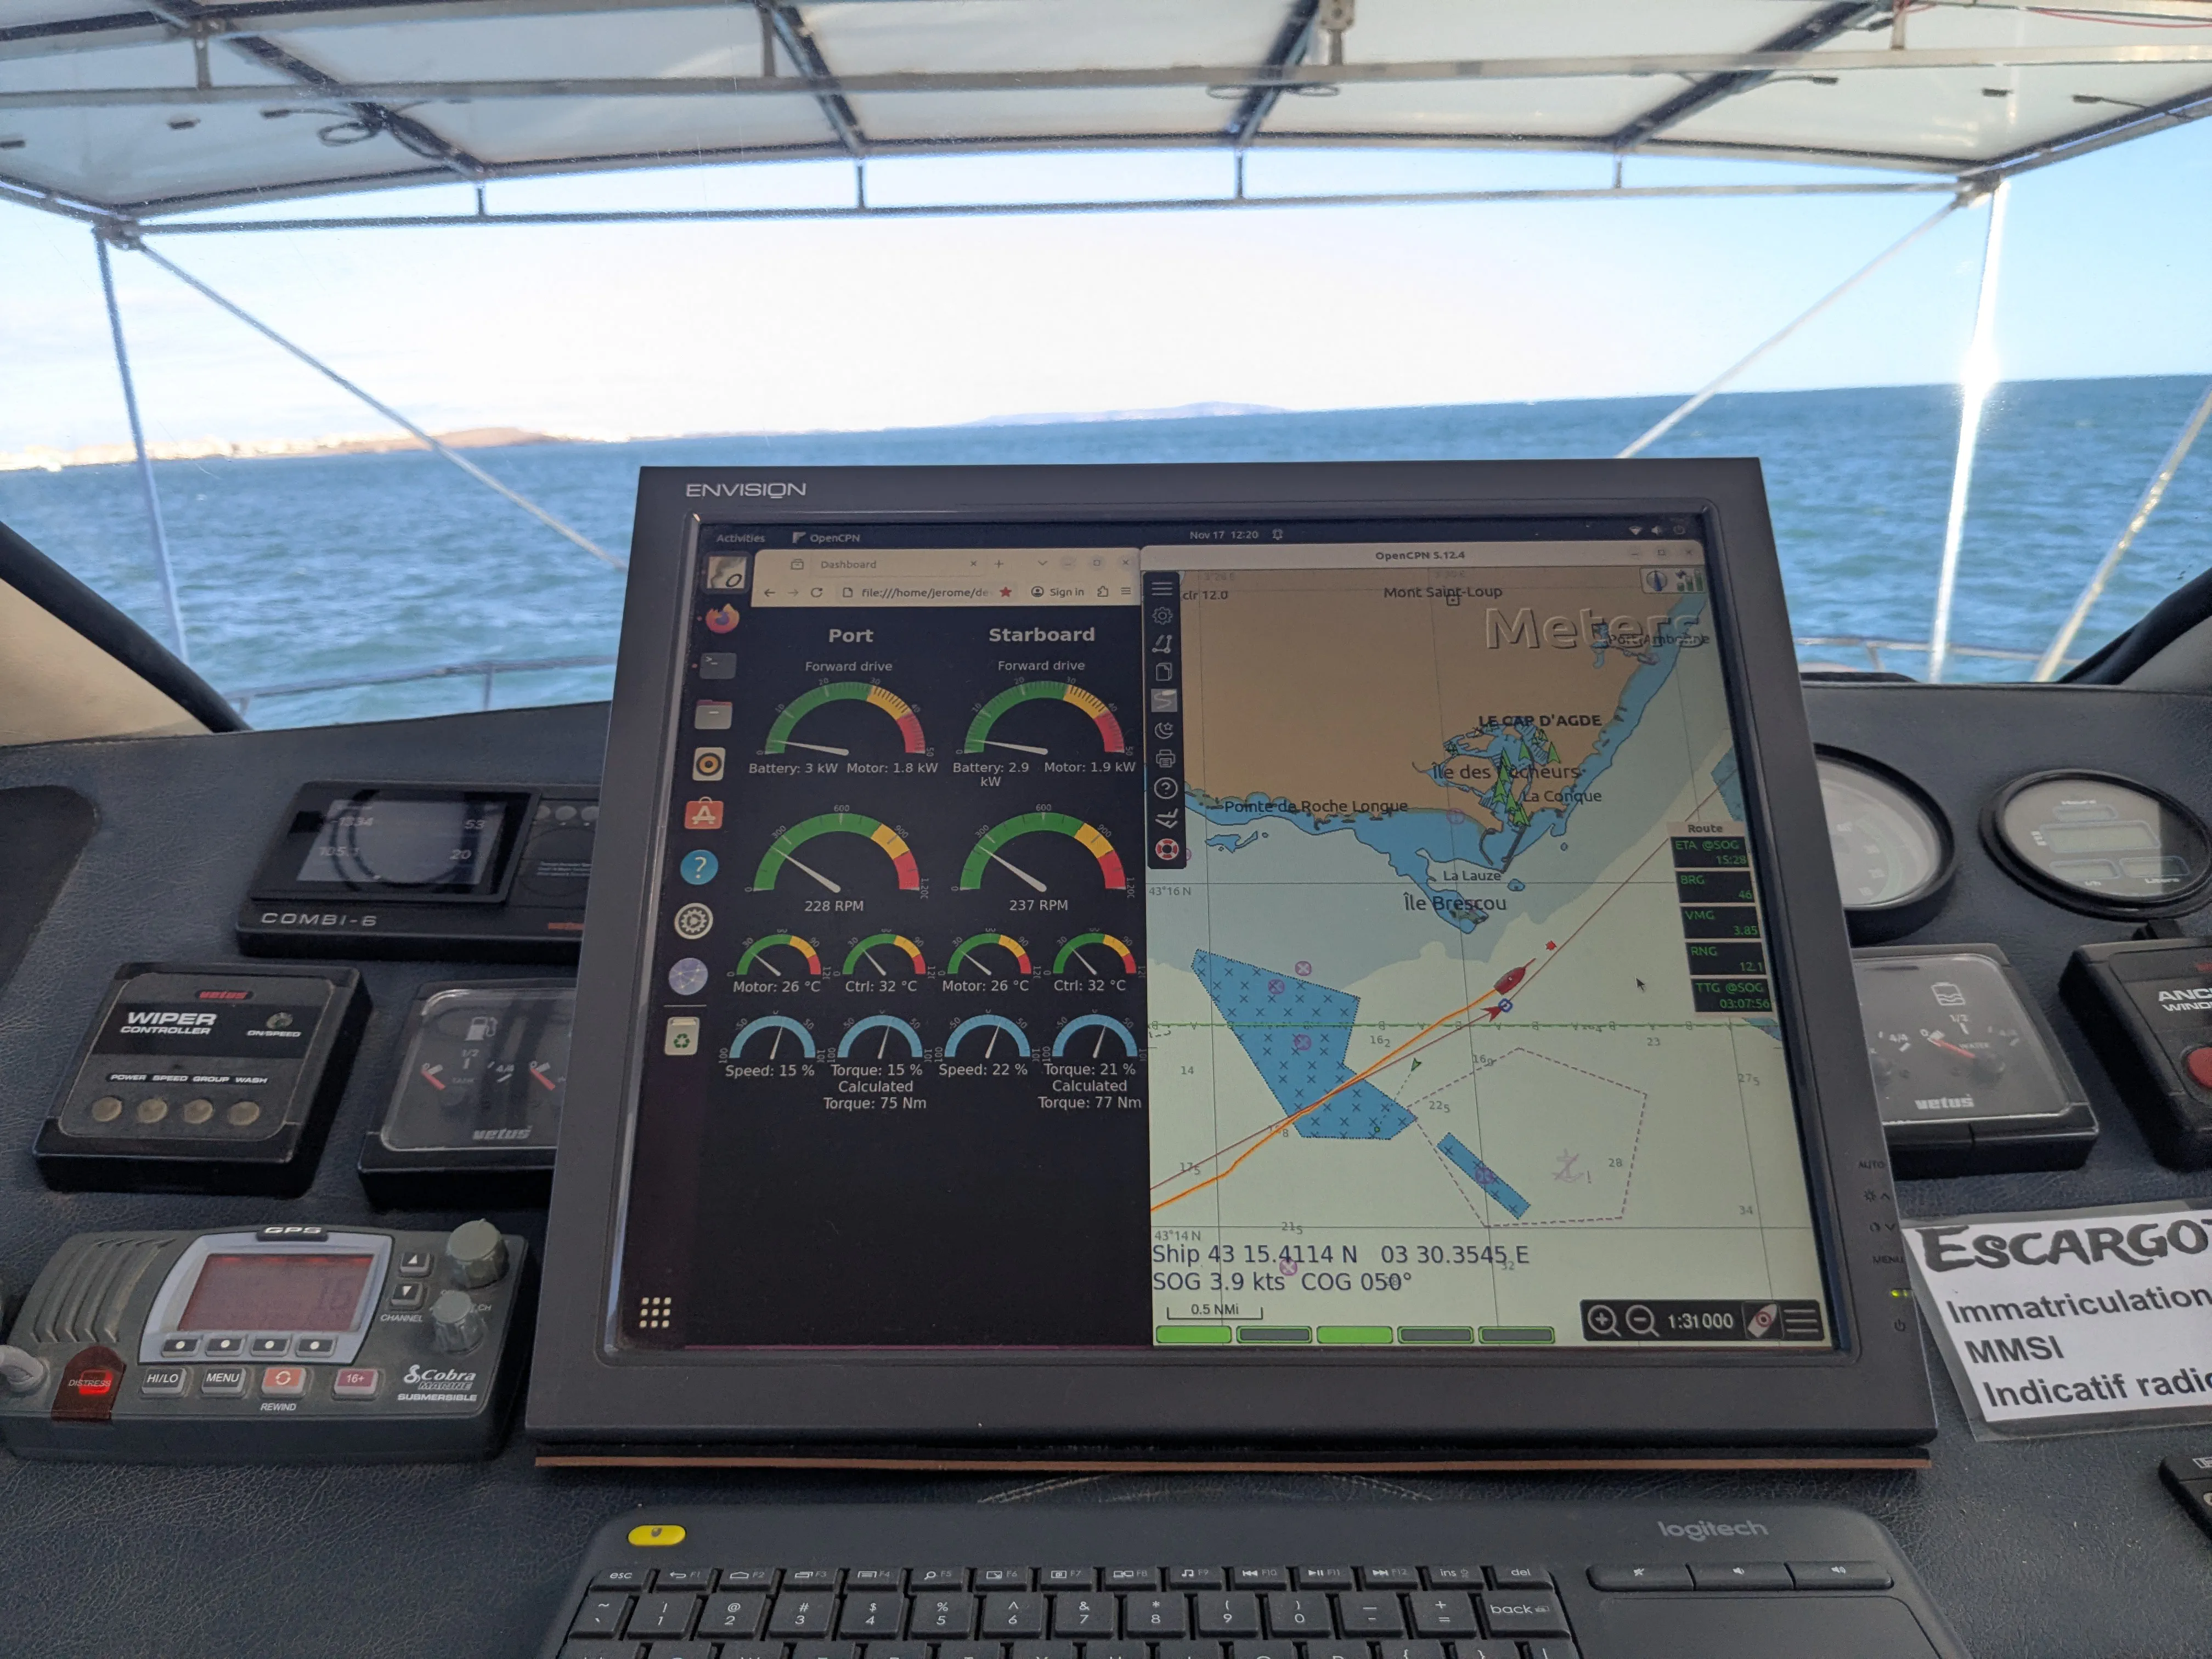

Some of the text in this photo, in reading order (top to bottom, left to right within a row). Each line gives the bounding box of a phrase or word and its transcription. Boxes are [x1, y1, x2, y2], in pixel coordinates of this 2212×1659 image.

[686, 483, 807, 499] ENVISION
[716, 533, 765, 544] Activities
[809, 533, 861, 545] OpenCPN
[1190, 530, 1259, 540] Nov 17 12:20
[1375, 551, 1465, 562] OpenCPN 5.12.4
[821, 559, 877, 570] Dashboard
[1049, 586, 1085, 599] Sign in
[1202, 590, 1229, 601] 12.0
[1384, 586, 1503, 600] Mont Saint-Loup
[1485, 607, 1705, 650] Meters
[828, 628, 873, 644] Port
[989, 627, 1095, 643] Starboard
[805, 662, 893, 672] Forward drive
[998, 661, 1085, 671] Forward drive
[1479, 715, 1602, 726] LE CAP D'AGDE
[748, 763, 838, 774] Battery: 3 kW
[847, 763, 938, 773] Motor: 1.8 kW
[953, 762, 1029, 774] Battery: 2.9
[1045, 761, 1136, 772] Motor: 1.9 kW
[1431, 761, 1491, 779] Île des
[980, 776, 1001, 787] kW
[1523, 791, 1602, 805] La Conque
[1224, 800, 1408, 816] Pointe de Roche Longue
[1688, 825, 1723, 833] Route
[1675, 840, 1740, 852] ETA @SOG
[1443, 870, 1502, 881] La Lauze
[1680, 875, 1706, 885] BRG
[1149, 886, 1192, 896] 43°16 N
[1738, 890, 1753, 900] 46
[804, 900, 864, 911] 228 RPM
[1009, 900, 1069, 911] 237 RPM
[1404, 892, 1506, 911] Île Brescou
[261, 912, 377, 927] COMBI-6
[1685, 910, 1716, 921] VMG
[1734, 926, 1758, 935] 3.85
[1691, 946, 1718, 956] RNG
[733, 981, 821, 992] Motor: 26 °C
[845, 980, 917, 992] Ctrl: 32 °C
[943, 980, 1029, 991] Motor: 26 °C
[1054, 980, 1126, 991] Ctrl: 32 °C
[1695, 983, 1764, 995] TTG @SOG
[128, 1012, 217, 1026] WIPER
[120, 1026, 212, 1035] CONTROLLER
[1646, 1037, 1661, 1046] 23
[725, 1064, 797, 1078] Speed: 15
[830, 1064, 905, 1078] Torque: 15
[939, 1064, 1009, 1077] Speed: 22
[1043, 1063, 1117, 1077] Torque: 21
[1181, 1066, 1194, 1075] 14
[838, 1080, 913, 1093] Calculated
[1052, 1080, 1127, 1092] Calculated
[823, 1097, 927, 1111] Torque: 75 Nm
[1038, 1097, 1142, 1110] Torque: 77 Nm
[1915, 1094, 1974, 1109] vetus
[473, 1126, 531, 1141] vetus
[264, 1226, 323, 1234] GPS
[1154, 1229, 1201, 1241] 43°14 N
[1153, 1244, 1530, 1268] Ship 43 15.4114 N 03 30.3545 E
[1153, 1272, 1201, 1291] SOG
[1210, 1272, 1244, 1291] 3.9
[1253, 1271, 1285, 1291] kts
[1301, 1272, 1351, 1291] COG
[1190, 1303, 1239, 1316] 0.5 NMi
[1946, 1285, 2212, 1323] Immatriculation
[380, 1314, 424, 1322] CHANNEL
[1964, 1335, 2064, 1364] MMSI
[147, 1374, 178, 1384] HI/LO
[206, 1373, 240, 1383] MENU
[346, 1374, 364, 1383] 16+
[420, 1368, 476, 1381] Cobra
[68, 1379, 111, 1387] DISTRESS
[418, 1381, 473, 1391] MARINE
[1983, 1373, 2129, 1407] Indicatif
[397, 1393, 477, 1402] SUBMERSIBLE
[261, 1402, 296, 1411] REWIND
[1657, 1520, 1769, 1541] logitech
[1440, 1568, 1457, 1577] ins
[1511, 1568, 1531, 1576] del
[1490, 1603, 1533, 1614] back
